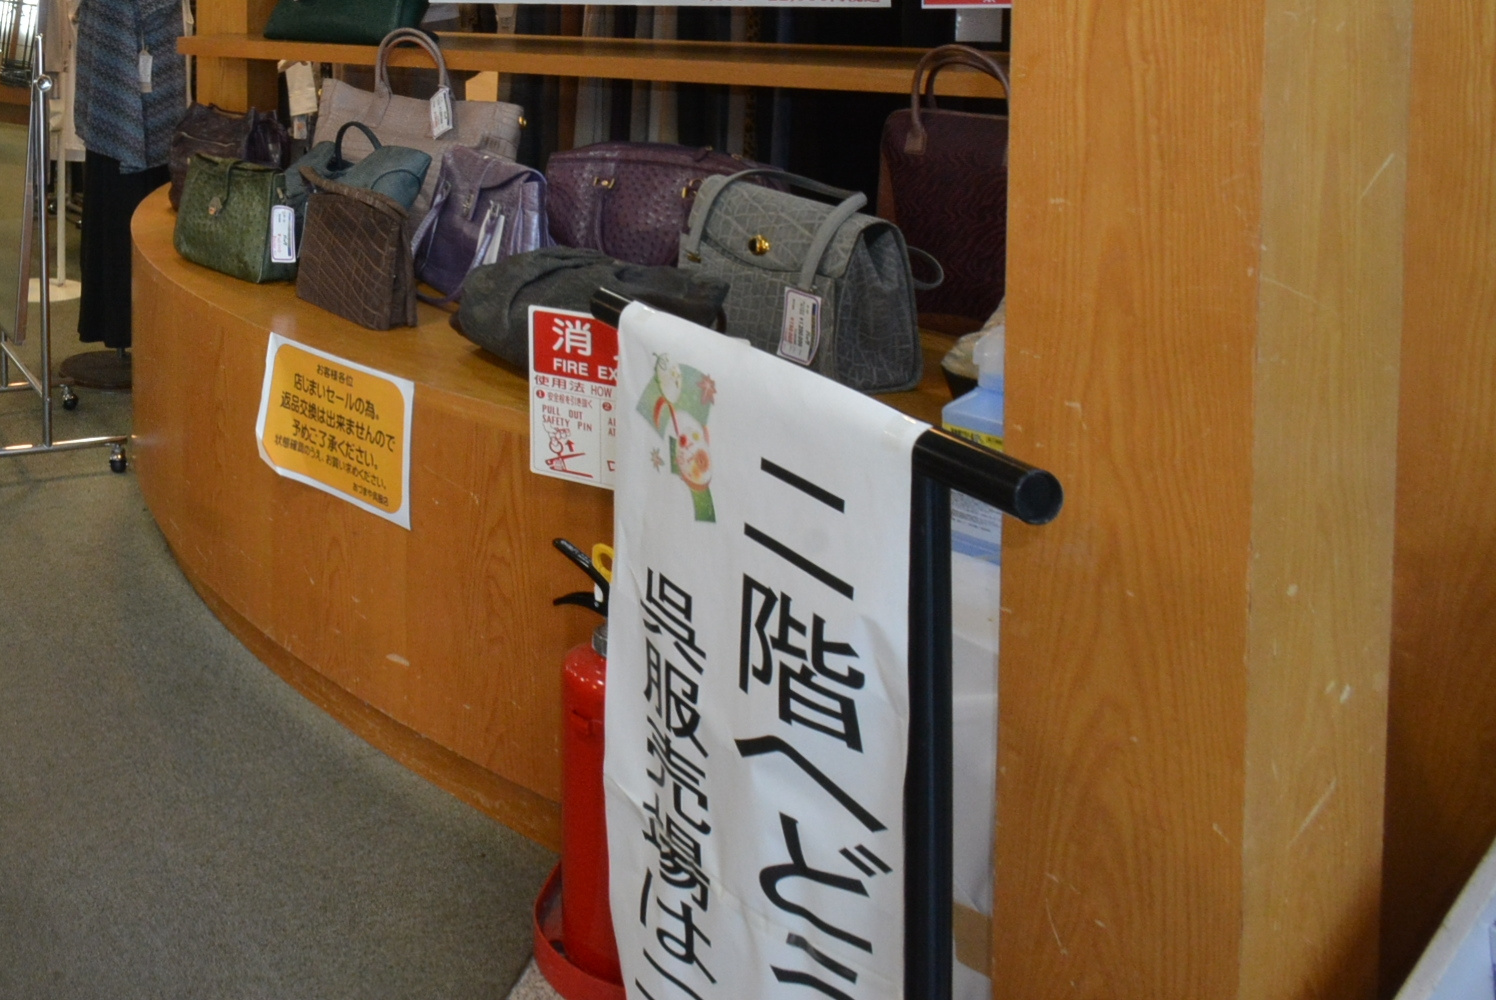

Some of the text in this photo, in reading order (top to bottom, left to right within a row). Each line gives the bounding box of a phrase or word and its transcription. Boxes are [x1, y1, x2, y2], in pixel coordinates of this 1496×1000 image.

[316, 363, 354, 388] お客様各位
[553, 357, 590, 377] FIRE
[534, 374, 613, 399] 使用法 HOW
[280, 390, 396, 453] 返品交換は出来ませんので
[542, 404, 583, 420] PULL OUT
[542, 414, 592, 432] SAFETY PIN
[292, 418, 379, 471] 予めご了承ください。
